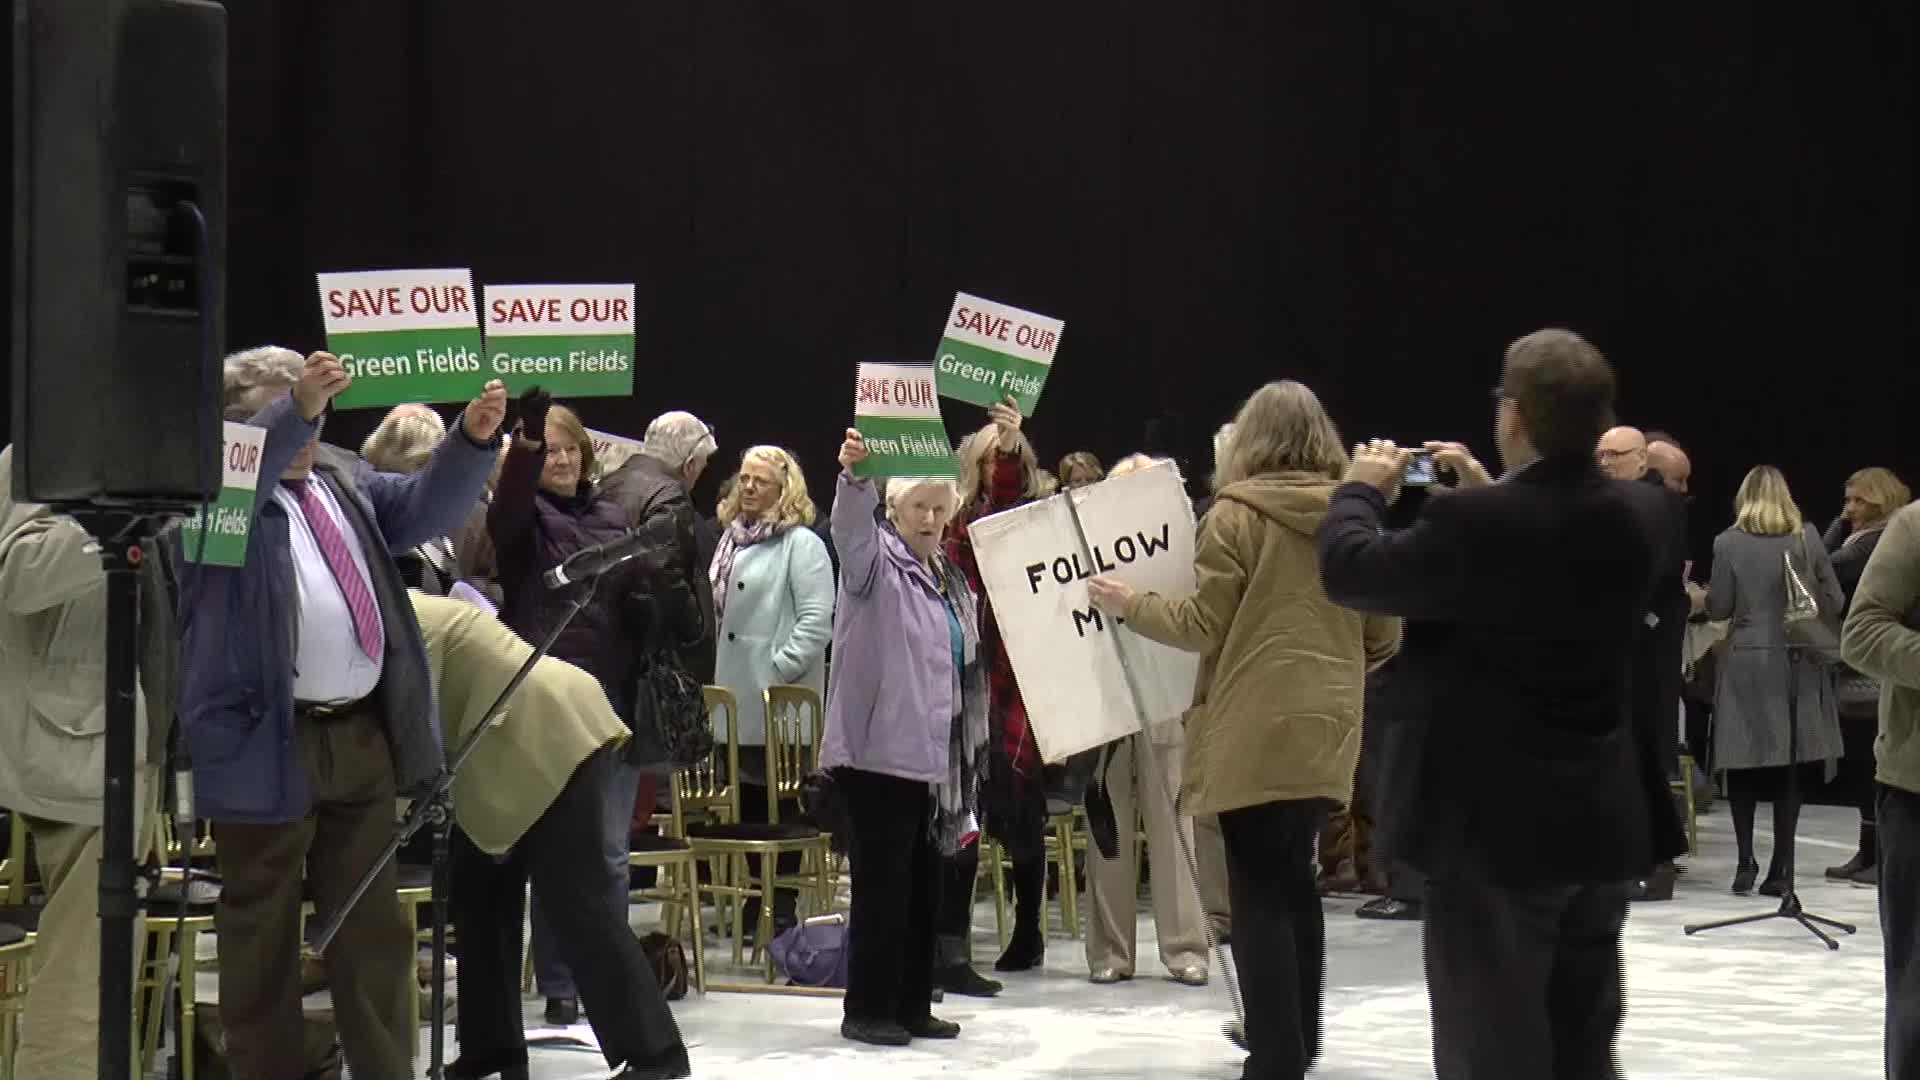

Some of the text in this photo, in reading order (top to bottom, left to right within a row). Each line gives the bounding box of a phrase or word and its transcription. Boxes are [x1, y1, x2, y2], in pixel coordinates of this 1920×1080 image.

[328, 285, 470, 318] SAVE OUR
[492, 298, 629, 323] SAVE OUR
[953, 306, 1056, 352] SAVE OUR
[340, 346, 480, 378] Green Fields
[492, 350, 629, 374] Green Fields
[938, 353, 1043, 396] Green Fields
[858, 377, 934, 407] SAVE OUR
[229, 442, 258, 473] OUR
[864, 432, 949, 458] reen Fields
[215, 507, 248, 536] Fields
[1025, 523, 1169, 594] FOLLOW
[1072, 606, 1125, 638] M
